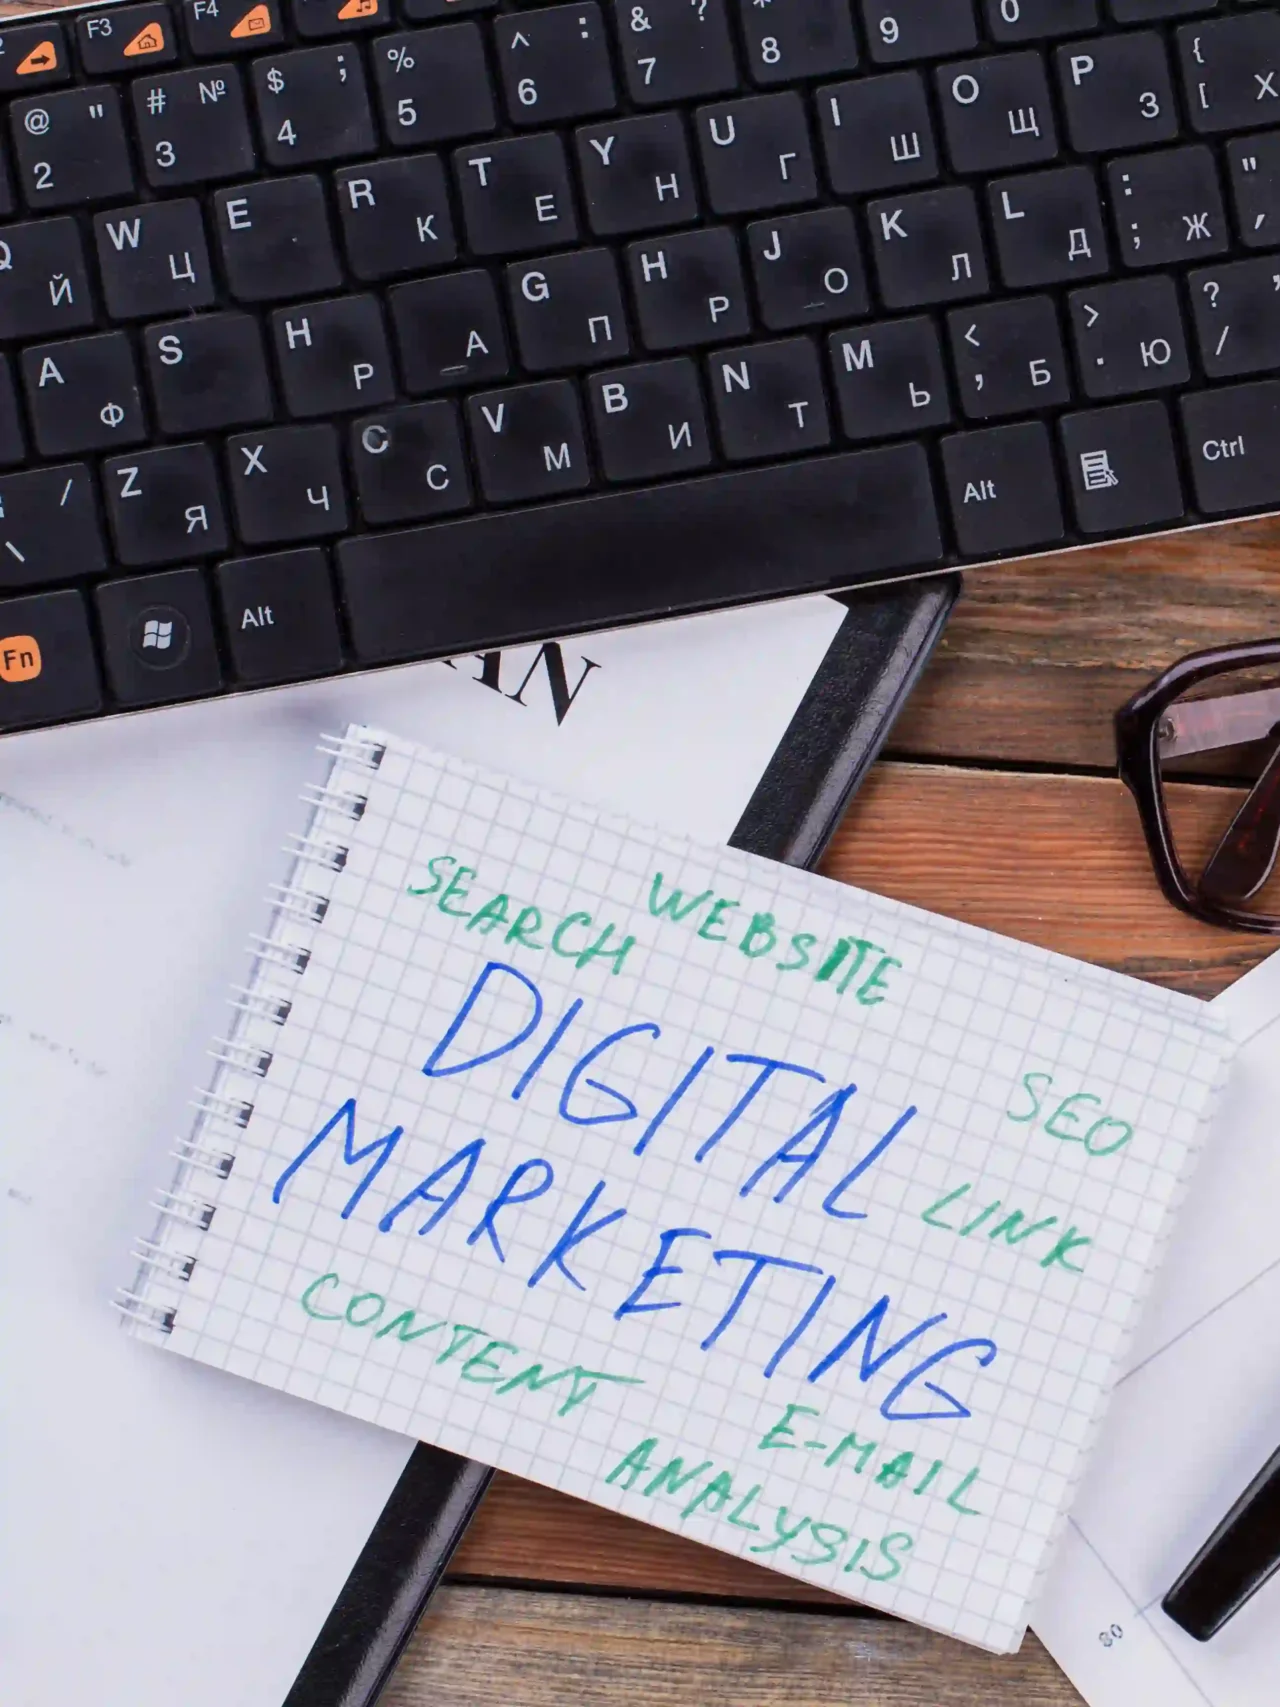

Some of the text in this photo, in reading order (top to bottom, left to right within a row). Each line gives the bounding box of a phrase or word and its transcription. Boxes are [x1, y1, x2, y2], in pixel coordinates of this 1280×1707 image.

[194, 0, 219, 20] F4
[87, 18, 112, 38] F3
[880, 17, 898, 43] 9
[762, 37, 780, 63] 8
[638, 57, 656, 84] 7
[1071, 56, 1093, 85] P
[199, 80, 225, 103] №
[518, 79, 537, 105] 6
[952, 75, 979, 104] O
[398, 99, 416, 125] 5
[831, 98, 840, 126] I
[278, 120, 296, 145] 4
[710, 116, 735, 145] U
[156, 141, 175, 167] 3
[590, 136, 614, 165] Y
[34, 162, 53, 189] 2
[469, 157, 491, 186] T
[348, 179, 375, 208] R
[1002, 192, 1024, 219] L
[227, 199, 251, 229] E
[881, 209, 907, 240] K
[106, 219, 140, 250] W
[764, 231, 780, 260] J
[641, 251, 667, 281] H
[522, 272, 549, 301] G
[286, 318, 311, 349] H
[159, 335, 182, 364] S
[843, 340, 873, 371] M
[39, 357, 64, 386] A
[722, 362, 750, 392] N
[602, 384, 628, 413] B
[482, 404, 504, 432] V
[362, 426, 388, 453] C
[1203, 436, 1244, 460] Ctrl
[241, 445, 267, 475] X
[117, 467, 142, 497] Z
[964, 480, 996, 503] Alt
[242, 606, 274, 629] Alt
[4, 649, 34, 670] Fn
[406, 856, 638, 976] SEARCH
[648, 872, 902, 1006] WEBSITE
[422, 962, 918, 1219] DIGITAL
[1006, 1073, 1132, 1157] SEO
[921, 1183, 1091, 1273] LINK
[272, 1099, 997, 1421] MARKETING
[300, 1272, 642, 1418] CONTENT
[758, 1402, 983, 1516] E-MAIL
[604, 1437, 914, 1582] ANALYSIS
